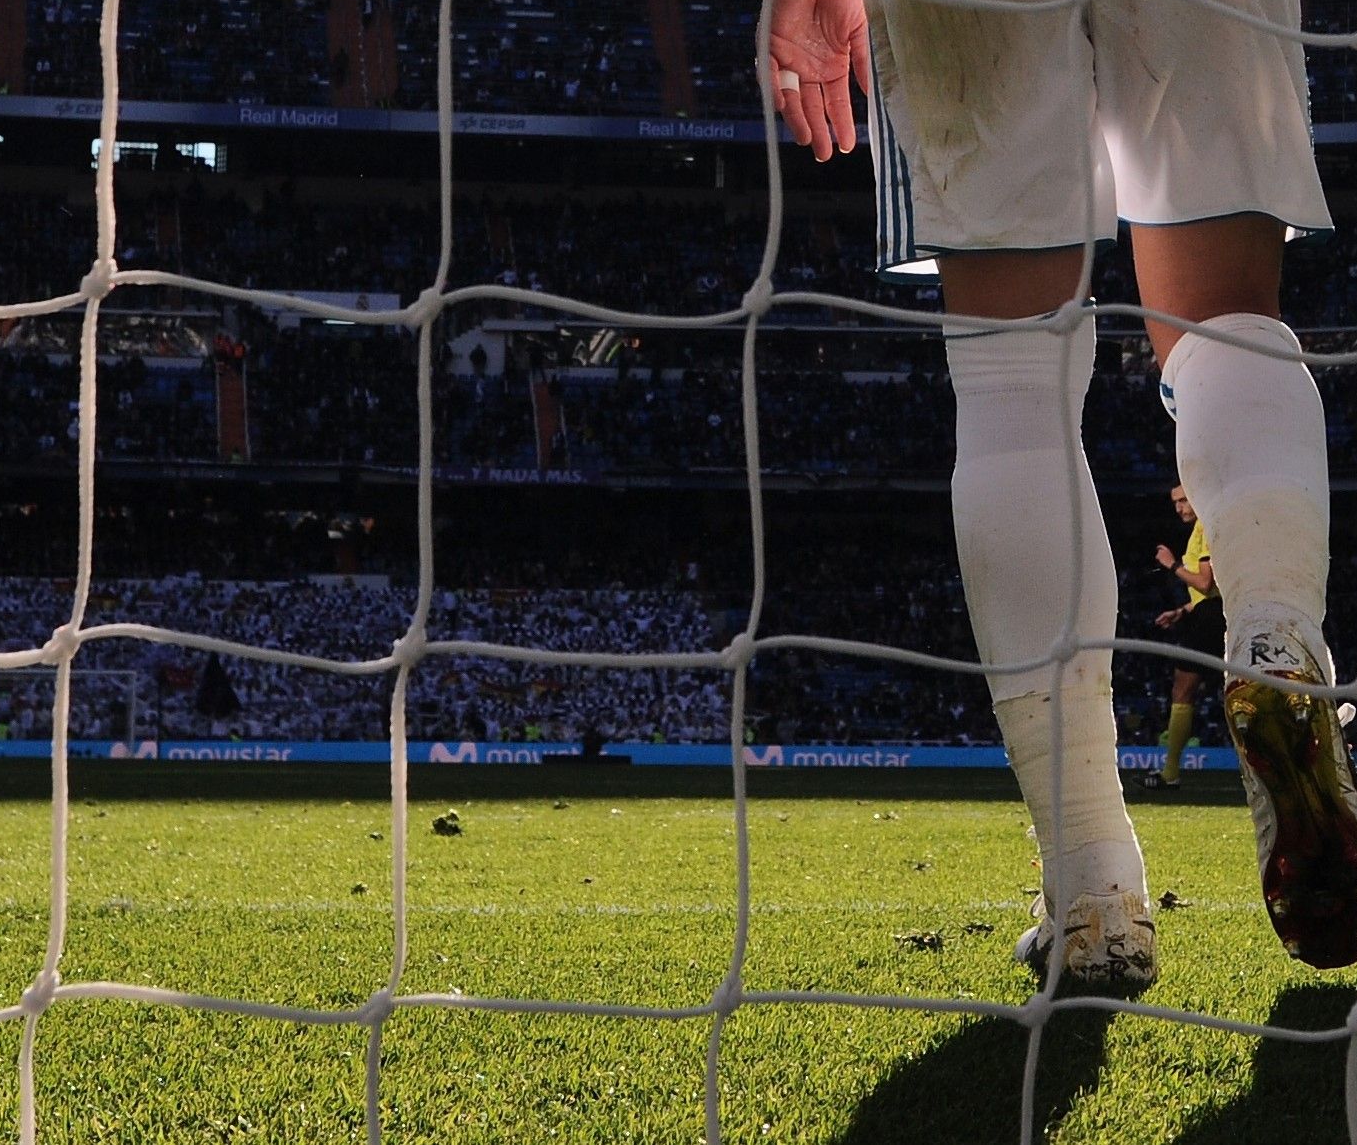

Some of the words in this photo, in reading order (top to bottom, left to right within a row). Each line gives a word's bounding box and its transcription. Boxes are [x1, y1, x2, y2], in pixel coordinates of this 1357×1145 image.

[239, 108, 276, 124] Real
[281, 109, 338, 126] Madrid
[479, 117, 526, 130] CEPSA
[639, 121, 674, 136] Real
[679, 122, 734, 139] Madrid
[489, 469, 540, 482] NADA
[168, 746, 293, 761] movistar
[792, 752, 911, 767] movistar
